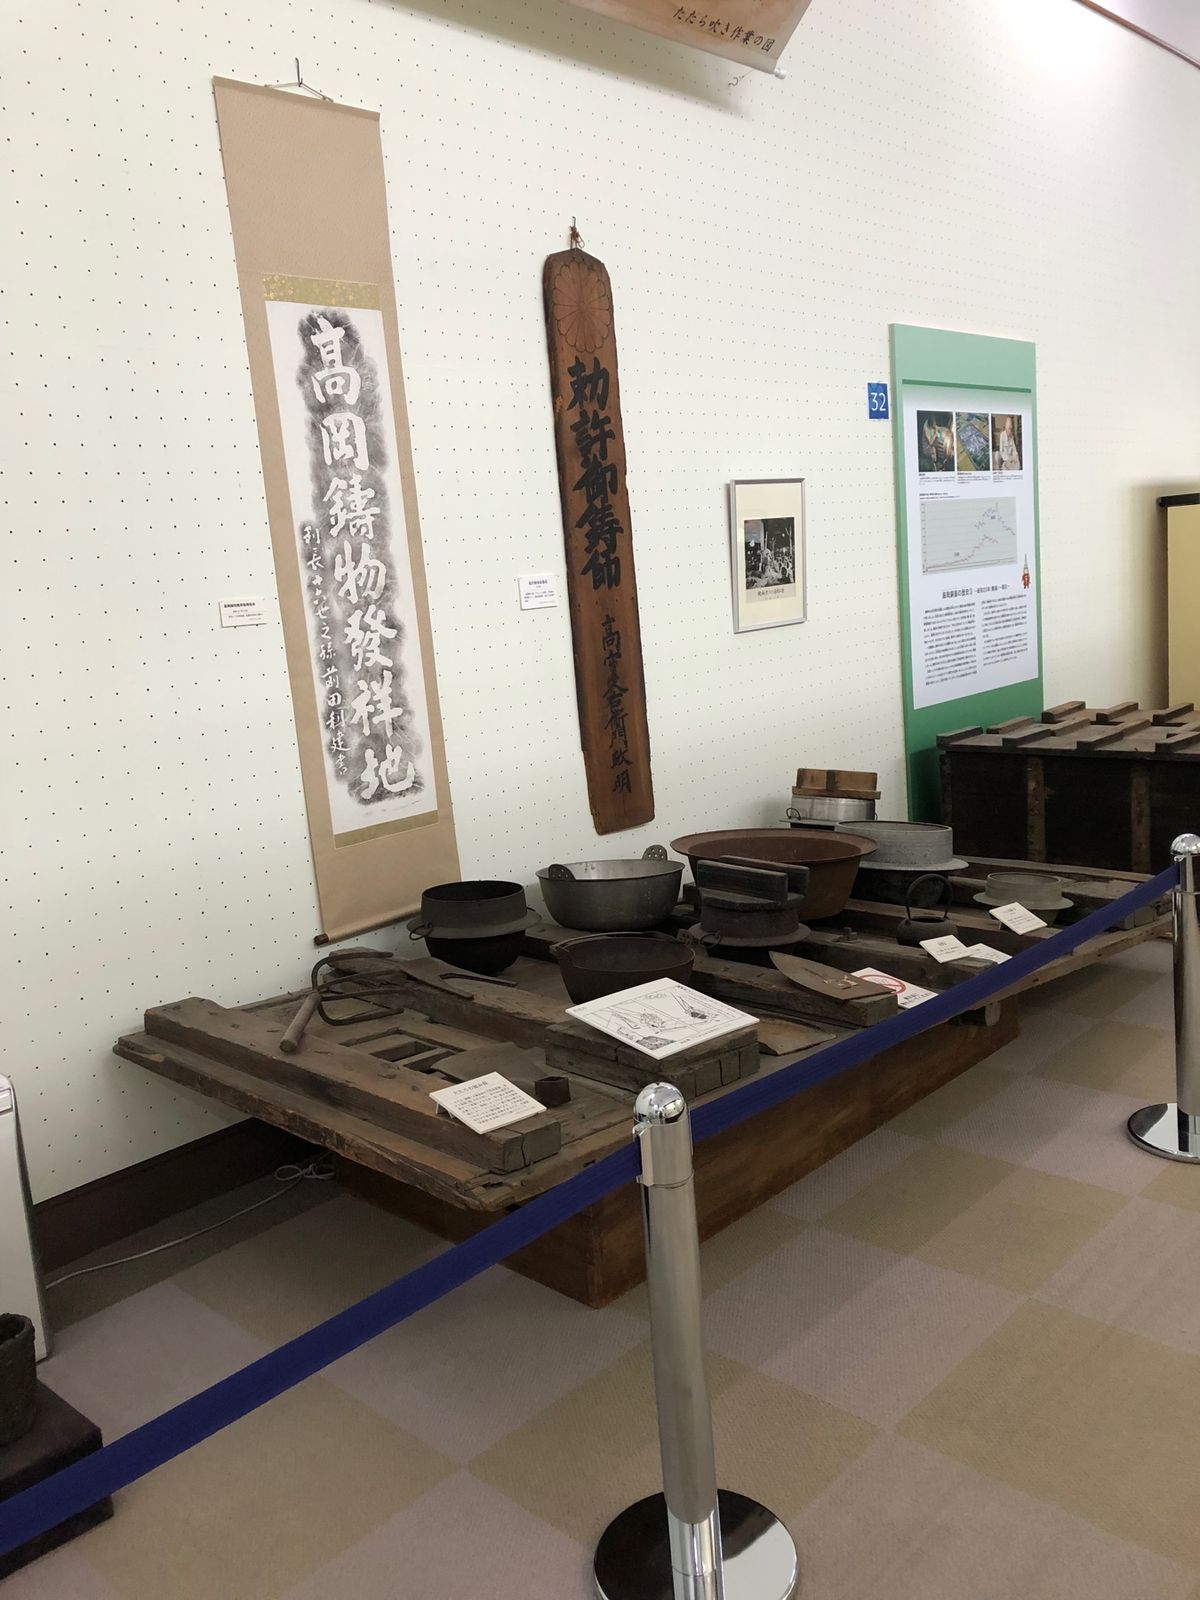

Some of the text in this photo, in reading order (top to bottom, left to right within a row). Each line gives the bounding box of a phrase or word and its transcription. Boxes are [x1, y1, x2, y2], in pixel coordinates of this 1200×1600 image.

[672, 6, 776, 52] たたら吹き作業の図
[870, 392, 887, 412] 32
